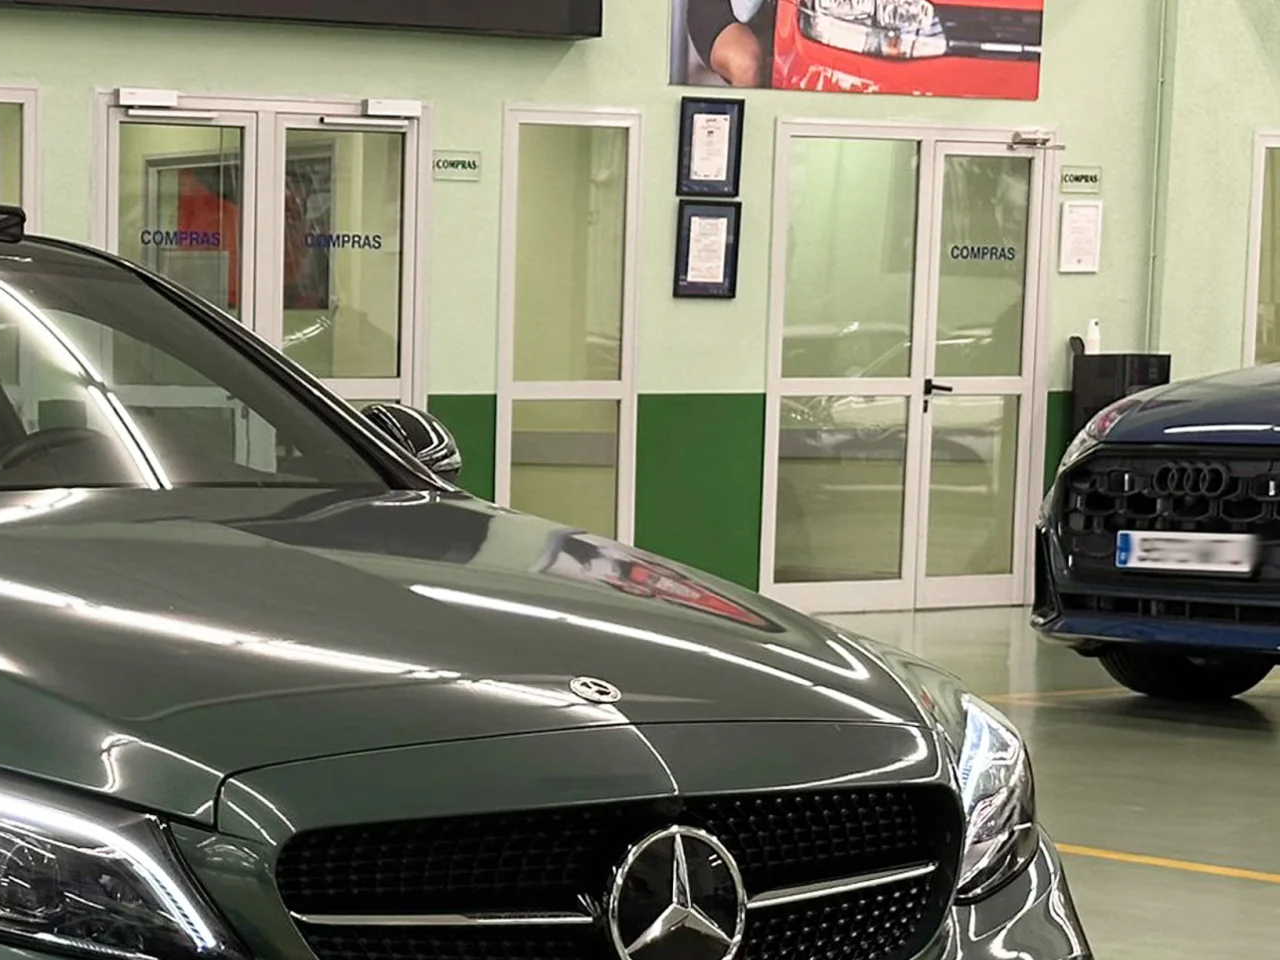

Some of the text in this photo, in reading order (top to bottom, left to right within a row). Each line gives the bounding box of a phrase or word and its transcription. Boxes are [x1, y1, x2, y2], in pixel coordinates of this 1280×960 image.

[436, 158, 477, 170] COMPRAS
[1063, 173, 1098, 184] COMPRAS
[140, 229, 221, 248] COMPRAS
[304, 232, 382, 250] COMPRAS
[950, 245, 1016, 261] COMPRAS
